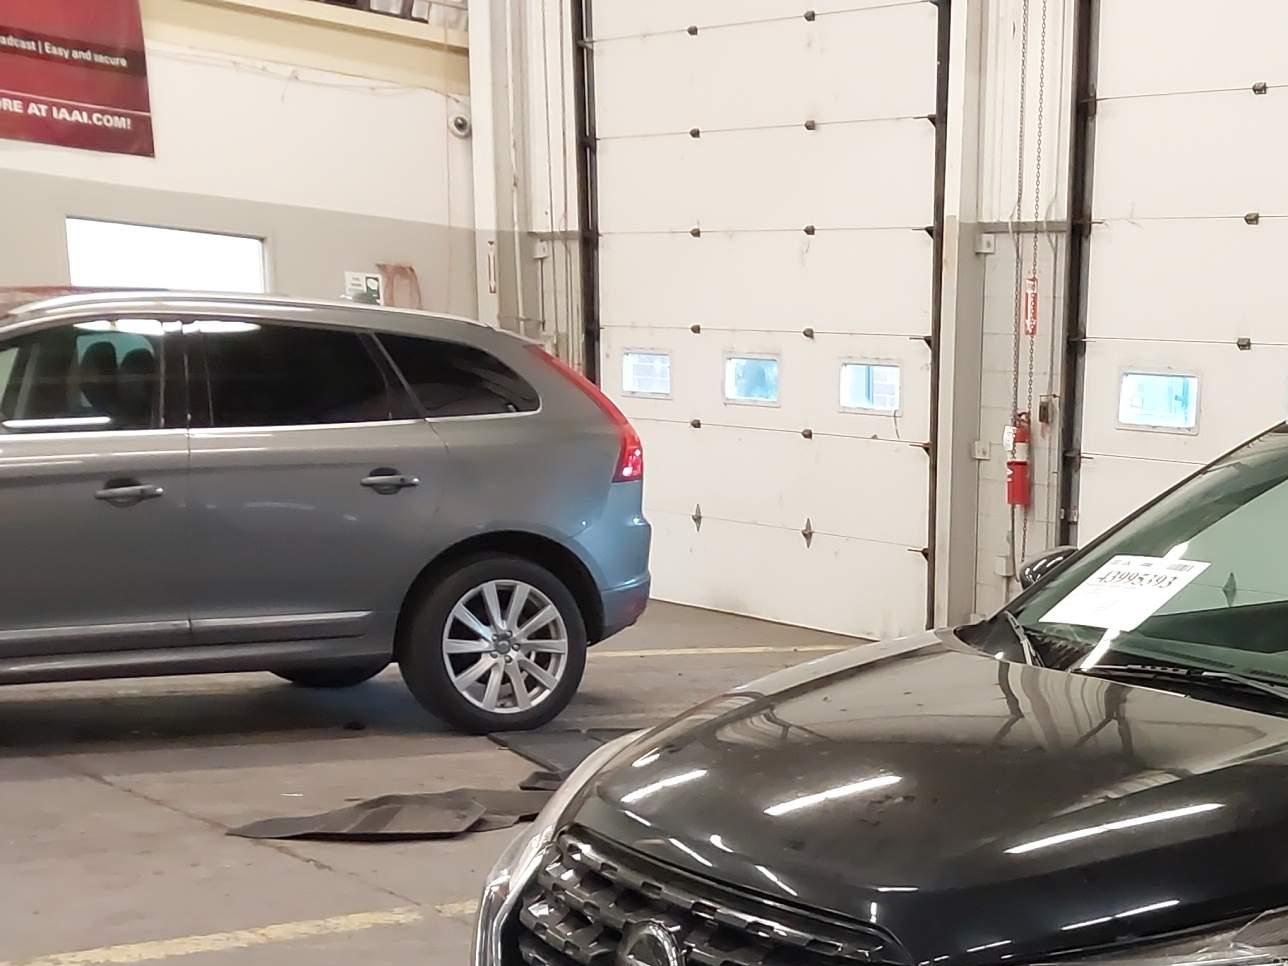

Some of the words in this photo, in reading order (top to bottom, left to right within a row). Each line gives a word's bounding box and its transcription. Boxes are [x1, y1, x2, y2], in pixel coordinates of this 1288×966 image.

[44, 42, 70, 59] Easy
[71, 50, 92, 61] and
[93, 54, 128, 67] secure
[0, 97, 24, 113] RE
[26, 102, 49, 117] AT
[52, 106, 132, 130] IAAI.COM!
